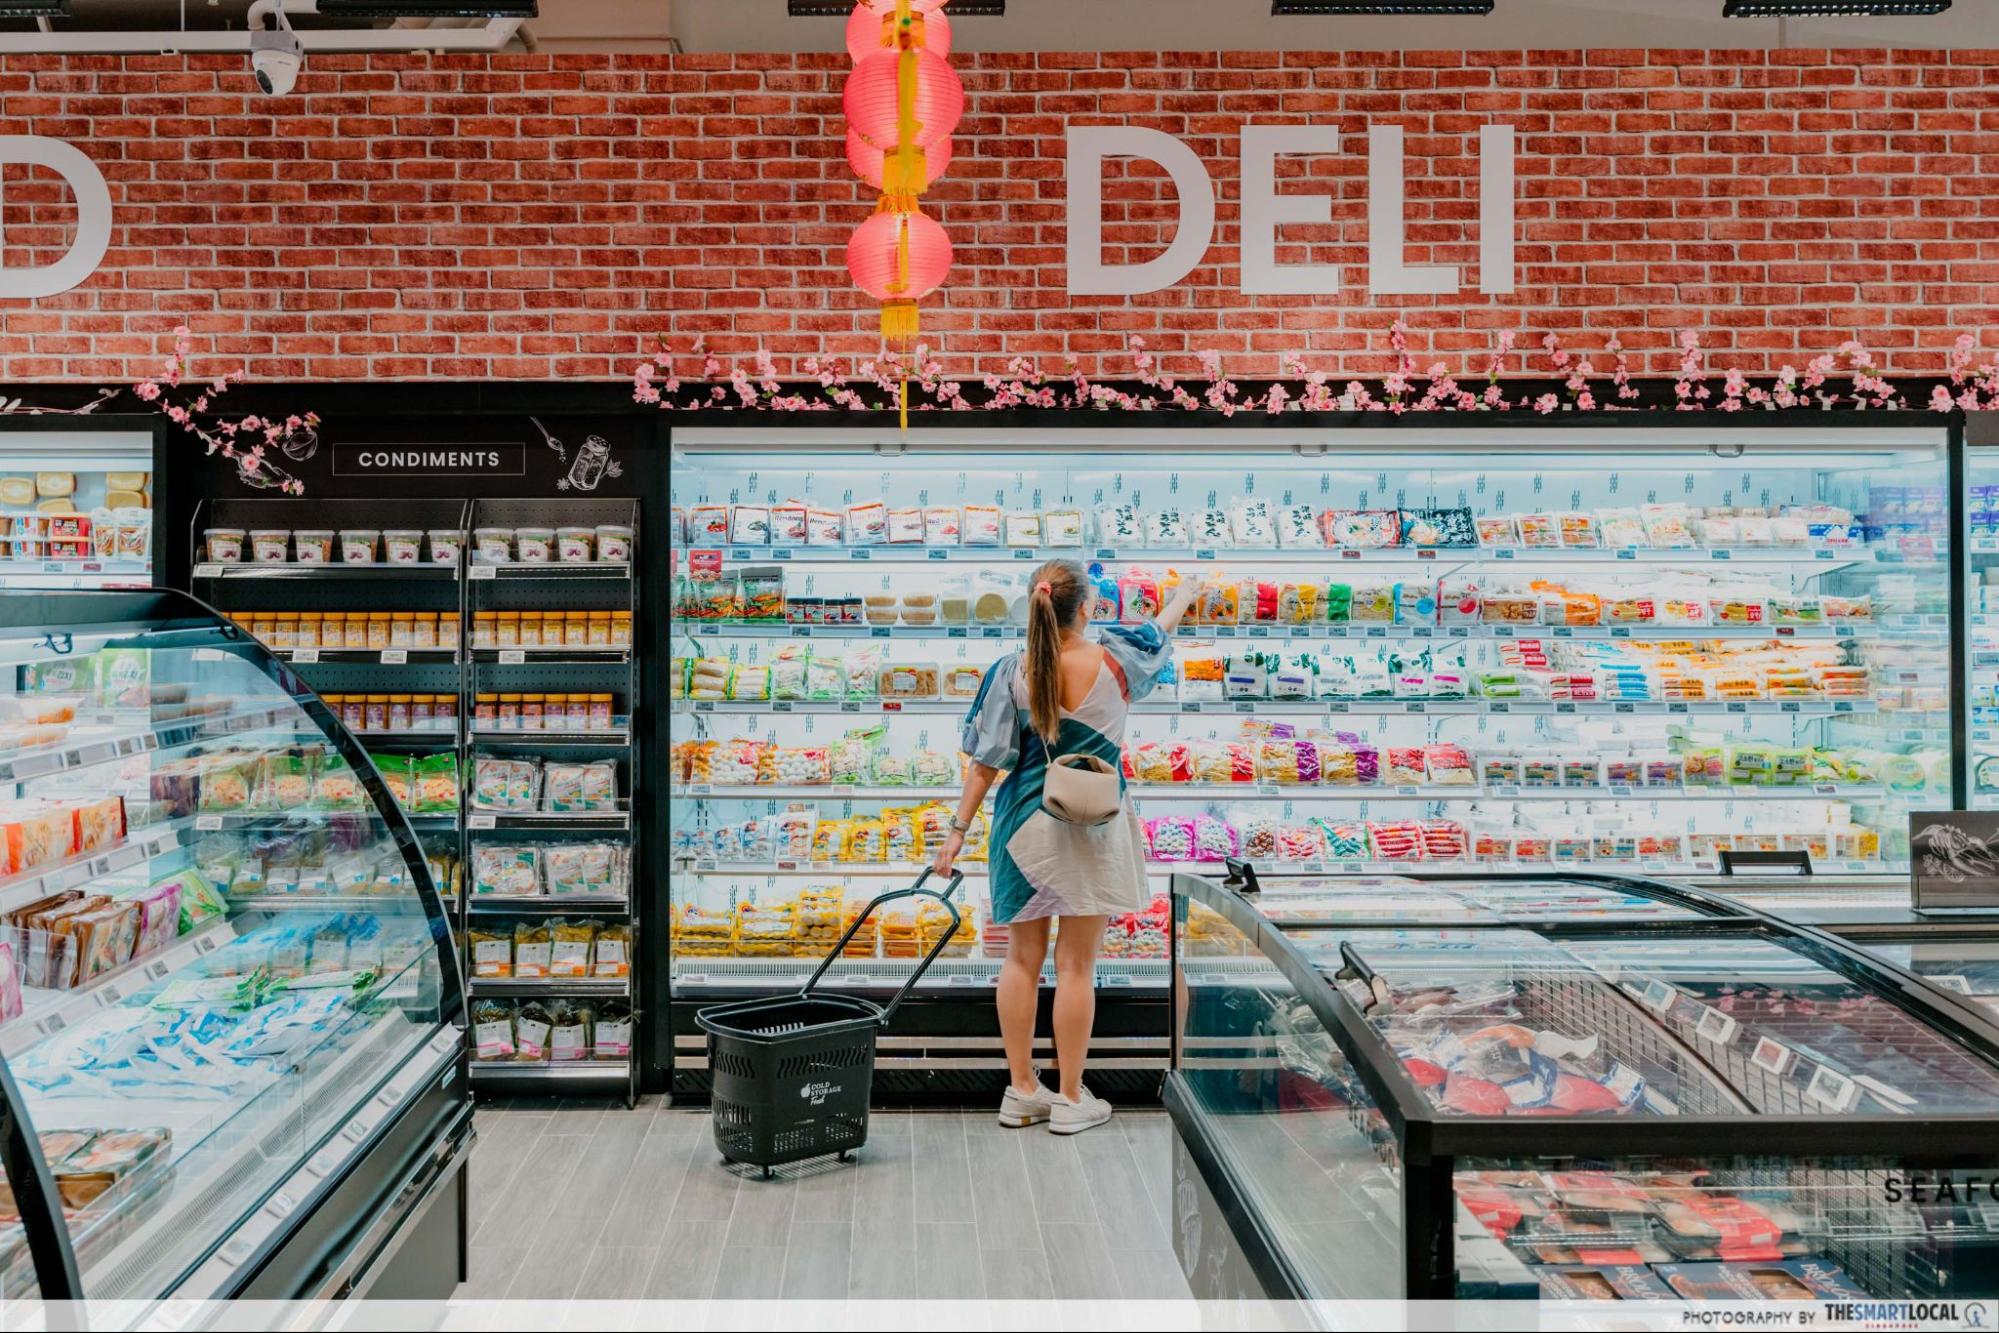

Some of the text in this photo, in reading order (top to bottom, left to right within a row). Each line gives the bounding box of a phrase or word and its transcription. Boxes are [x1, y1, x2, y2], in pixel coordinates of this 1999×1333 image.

[1067, 125, 1515, 296] DELI
[358, 451, 500, 467] CONDIMENTS
[811, 1081, 831, 1091] COLD
